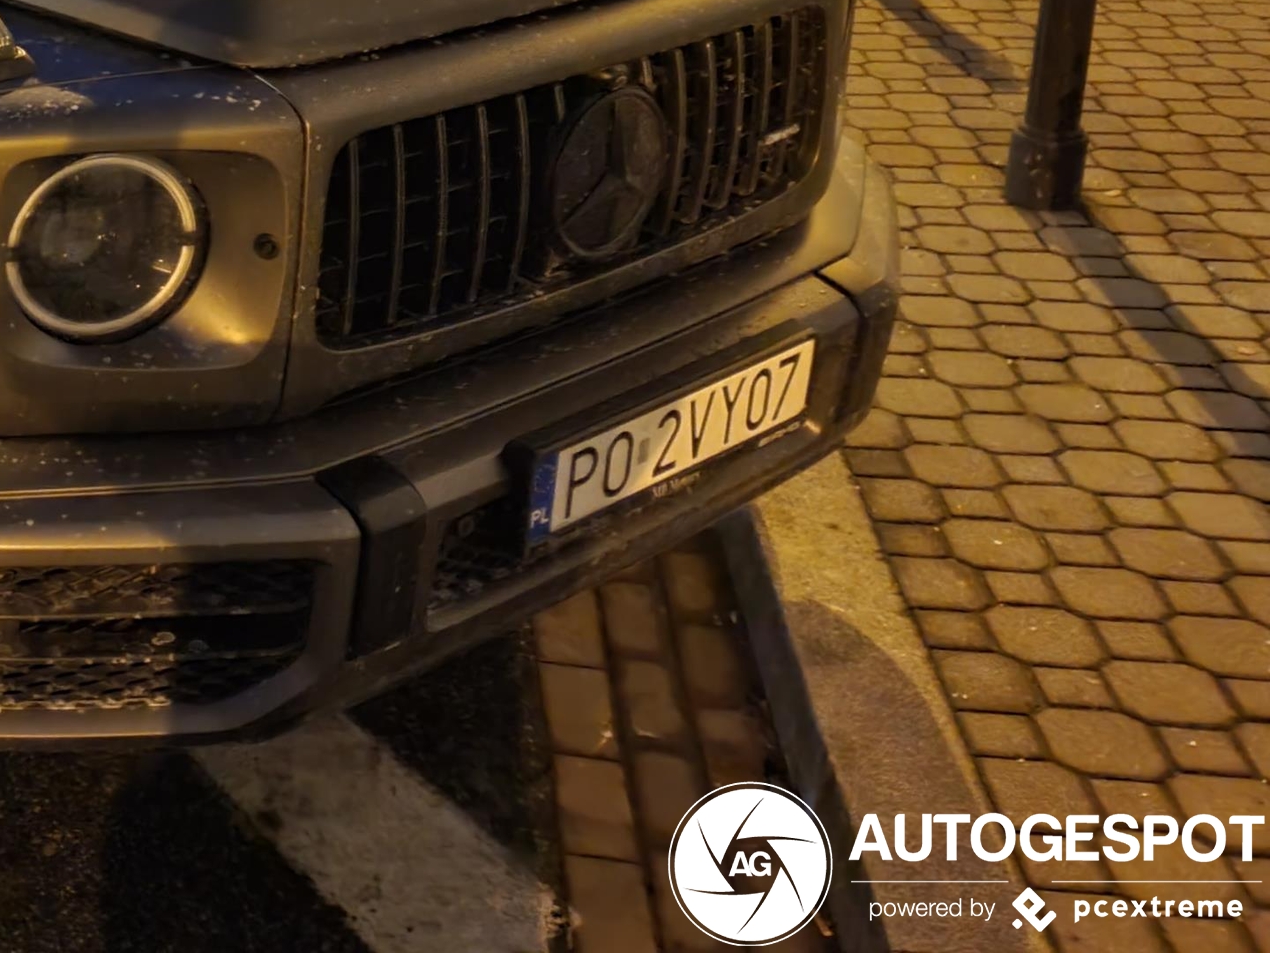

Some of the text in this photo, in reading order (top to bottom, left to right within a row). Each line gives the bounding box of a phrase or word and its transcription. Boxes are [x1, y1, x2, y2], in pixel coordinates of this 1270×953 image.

[564, 356, 800, 518] PO 2VY07
[530, 509, 549, 528] PL
